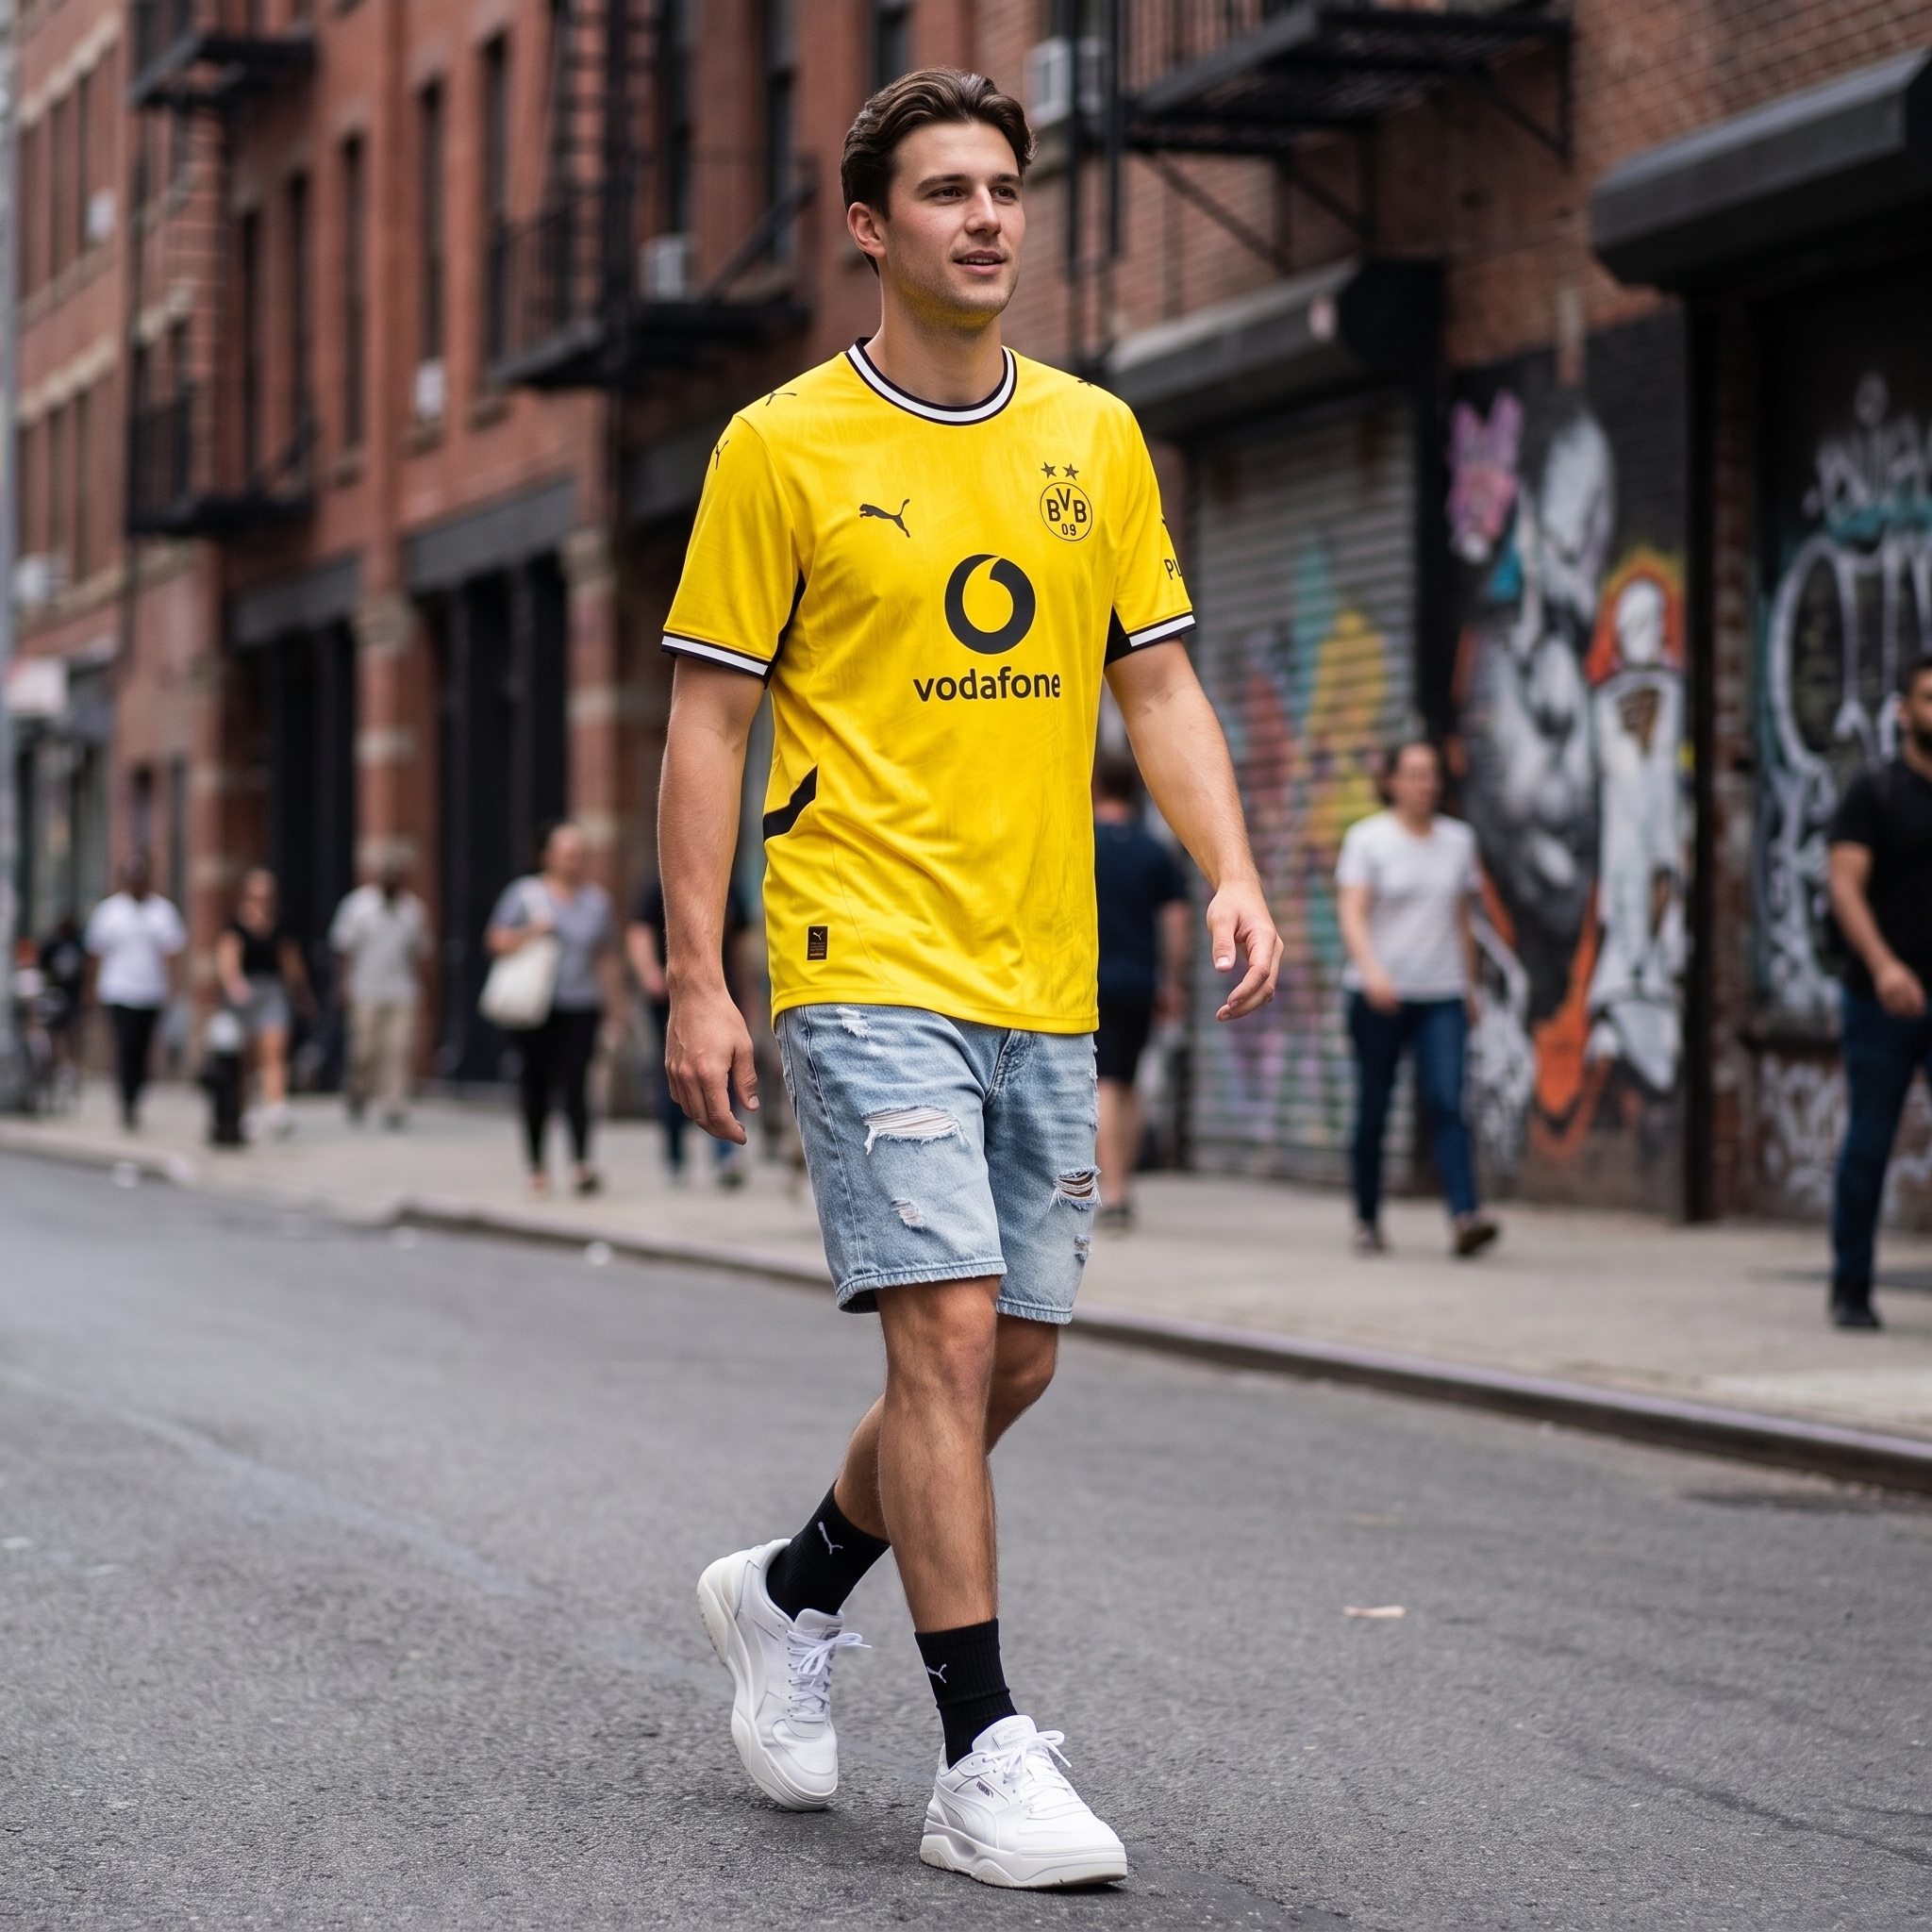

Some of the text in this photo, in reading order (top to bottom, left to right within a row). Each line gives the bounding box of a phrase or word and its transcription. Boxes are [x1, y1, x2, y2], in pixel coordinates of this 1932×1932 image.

[1045, 488, 1088, 524] BVB
[1061, 523, 1077, 537] 09
[912, 665, 1061, 702] vodafone
